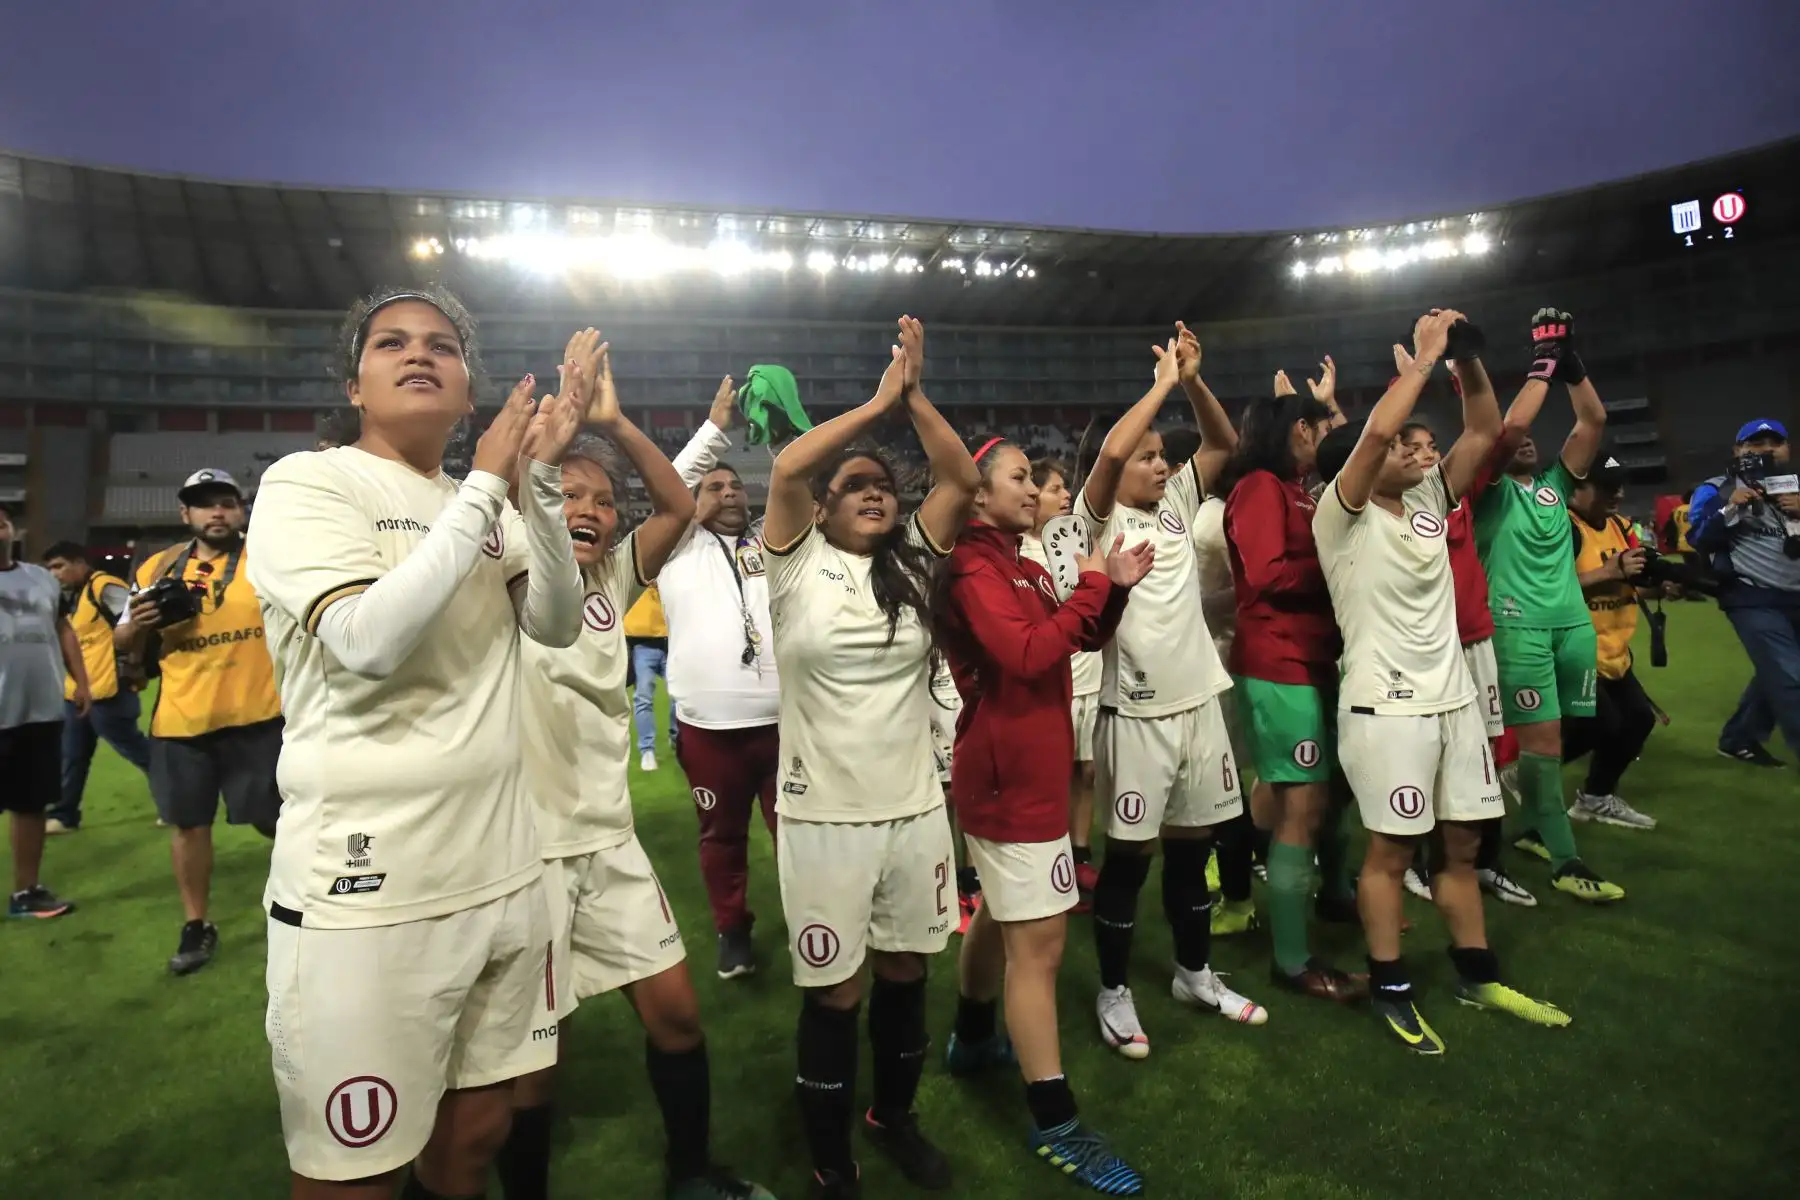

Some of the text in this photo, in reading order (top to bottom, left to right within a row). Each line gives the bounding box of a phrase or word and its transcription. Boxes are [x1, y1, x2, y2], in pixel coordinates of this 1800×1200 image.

[1720, 197, 1736, 219] U
[1685, 234, 1694, 246] 1
[1724, 226, 1733, 238] 2
[1163, 513, 1183, 531] U
[1416, 514, 1440, 532] U
[586, 596, 612, 626] U
[1518, 691, 1537, 708] U
[1300, 745, 1316, 764] U
[1222, 752, 1234, 792] 6
[1123, 797, 1141, 820] U
[1399, 791, 1419, 815] U
[1057, 859, 1071, 887] U
[807, 932, 829, 962] U
[341, 1087, 380, 1138] U
